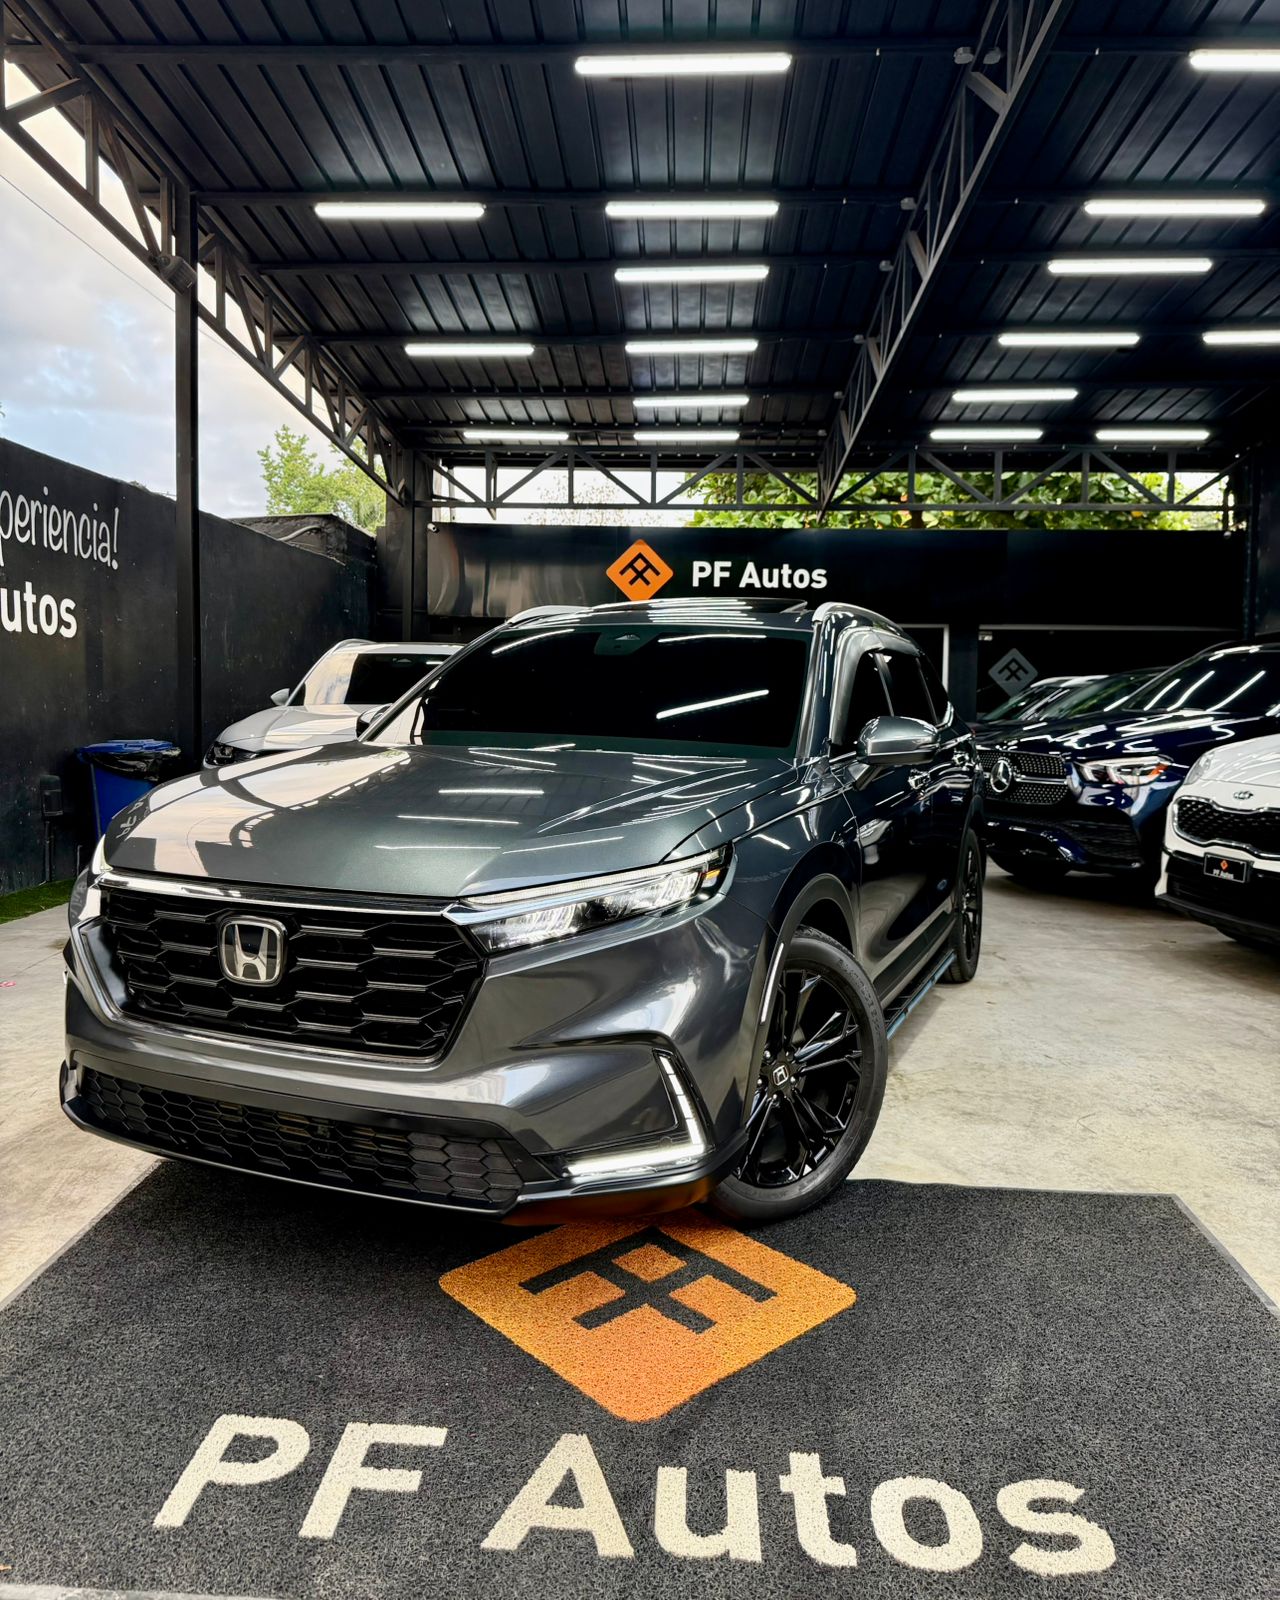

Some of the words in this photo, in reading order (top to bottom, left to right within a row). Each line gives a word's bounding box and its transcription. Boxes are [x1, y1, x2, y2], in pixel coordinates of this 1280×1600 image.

[692, 560, 732, 588] PF
[738, 561, 828, 589] Autos
[0, 581, 77, 638] utos
[152, 1413, 448, 1541] PF
[480, 1433, 1117, 1577] Autos
